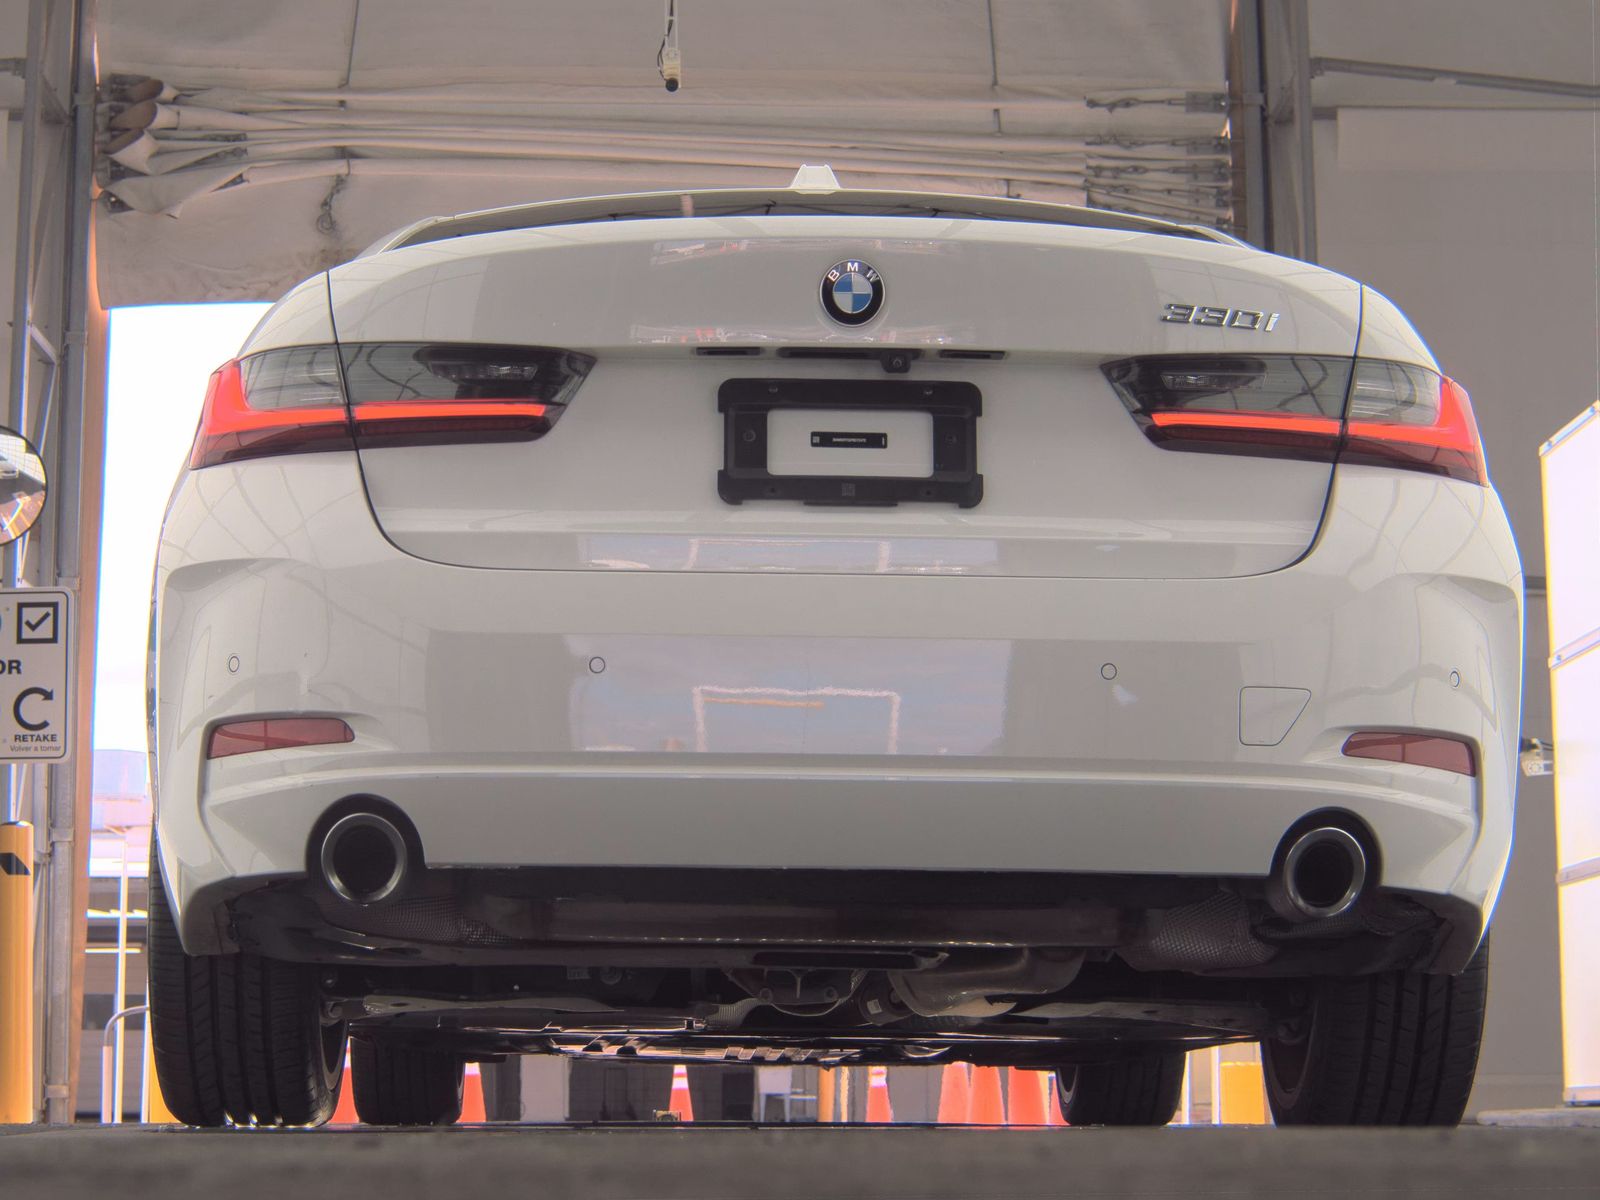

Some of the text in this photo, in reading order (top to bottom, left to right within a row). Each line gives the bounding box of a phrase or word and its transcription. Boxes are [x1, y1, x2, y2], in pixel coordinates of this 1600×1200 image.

[828, 262, 879, 282] BMW
[1161, 303, 1280, 332] 330i
[14, 734, 57, 742] RETAKE
